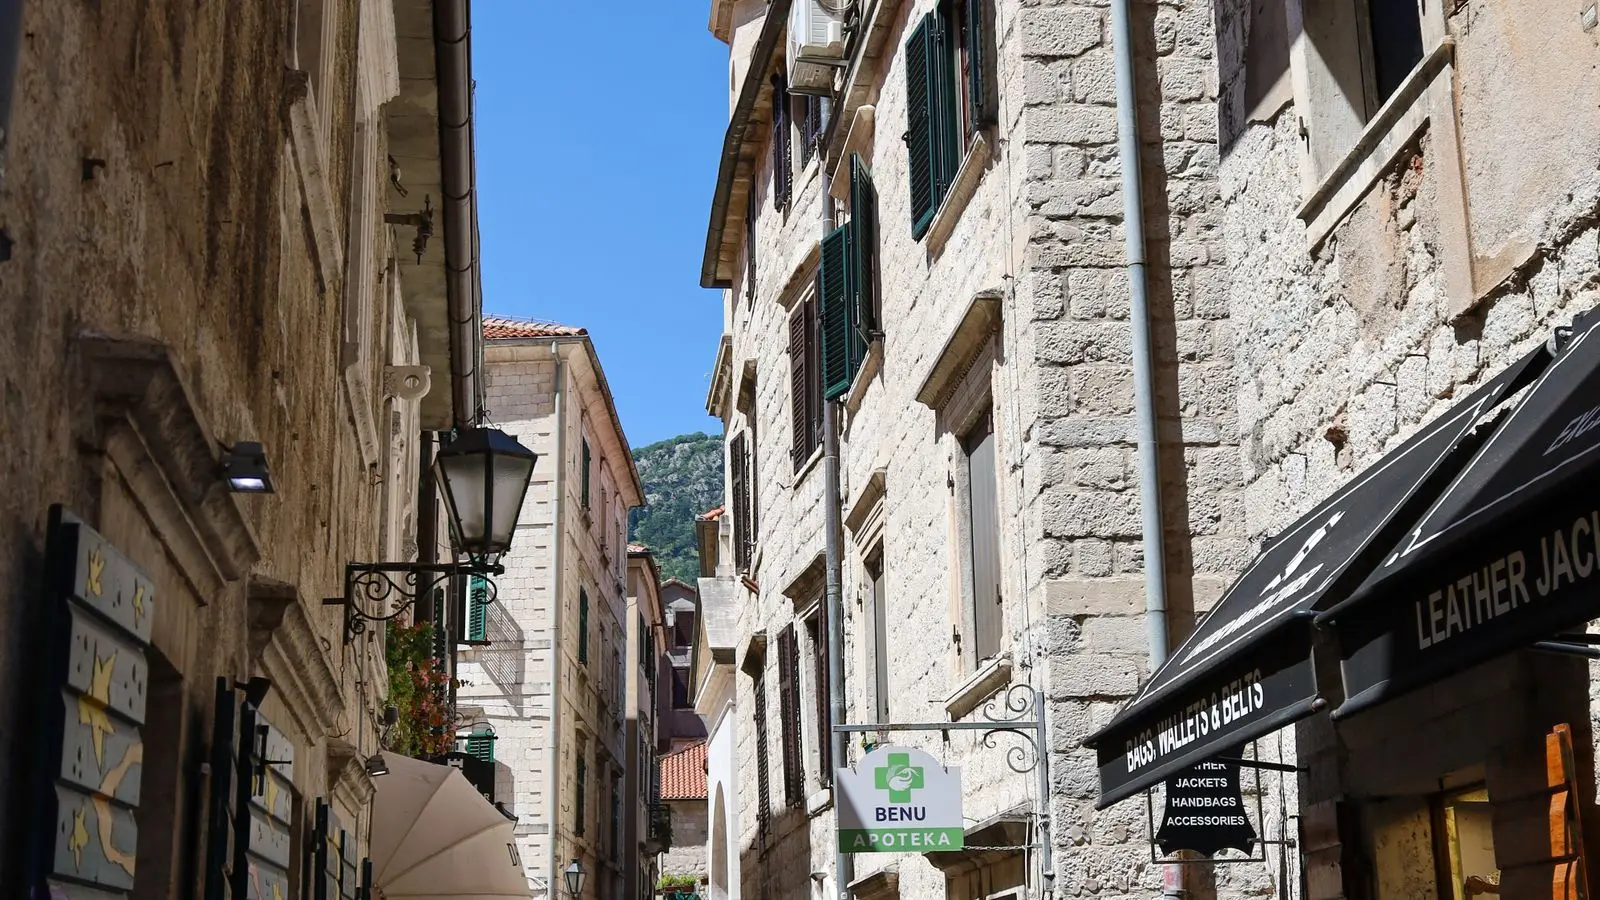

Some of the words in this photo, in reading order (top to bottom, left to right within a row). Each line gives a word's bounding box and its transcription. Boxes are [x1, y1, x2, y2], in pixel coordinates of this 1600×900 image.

[1416, 551, 1530, 650] LEATHER
[1126, 725, 1156, 773] BAGS,
[1157, 697, 1209, 757] WALLETS
[1211, 692, 1221, 731] &
[1222, 668, 1264, 726] BELTS
[1175, 778, 1228, 788] JACKETS
[1172, 797, 1236, 807] HANDBAGS
[875, 807, 926, 821] BENU
[1167, 816, 1245, 827] ACCESSORIES
[853, 832, 950, 847] APOTEKA
